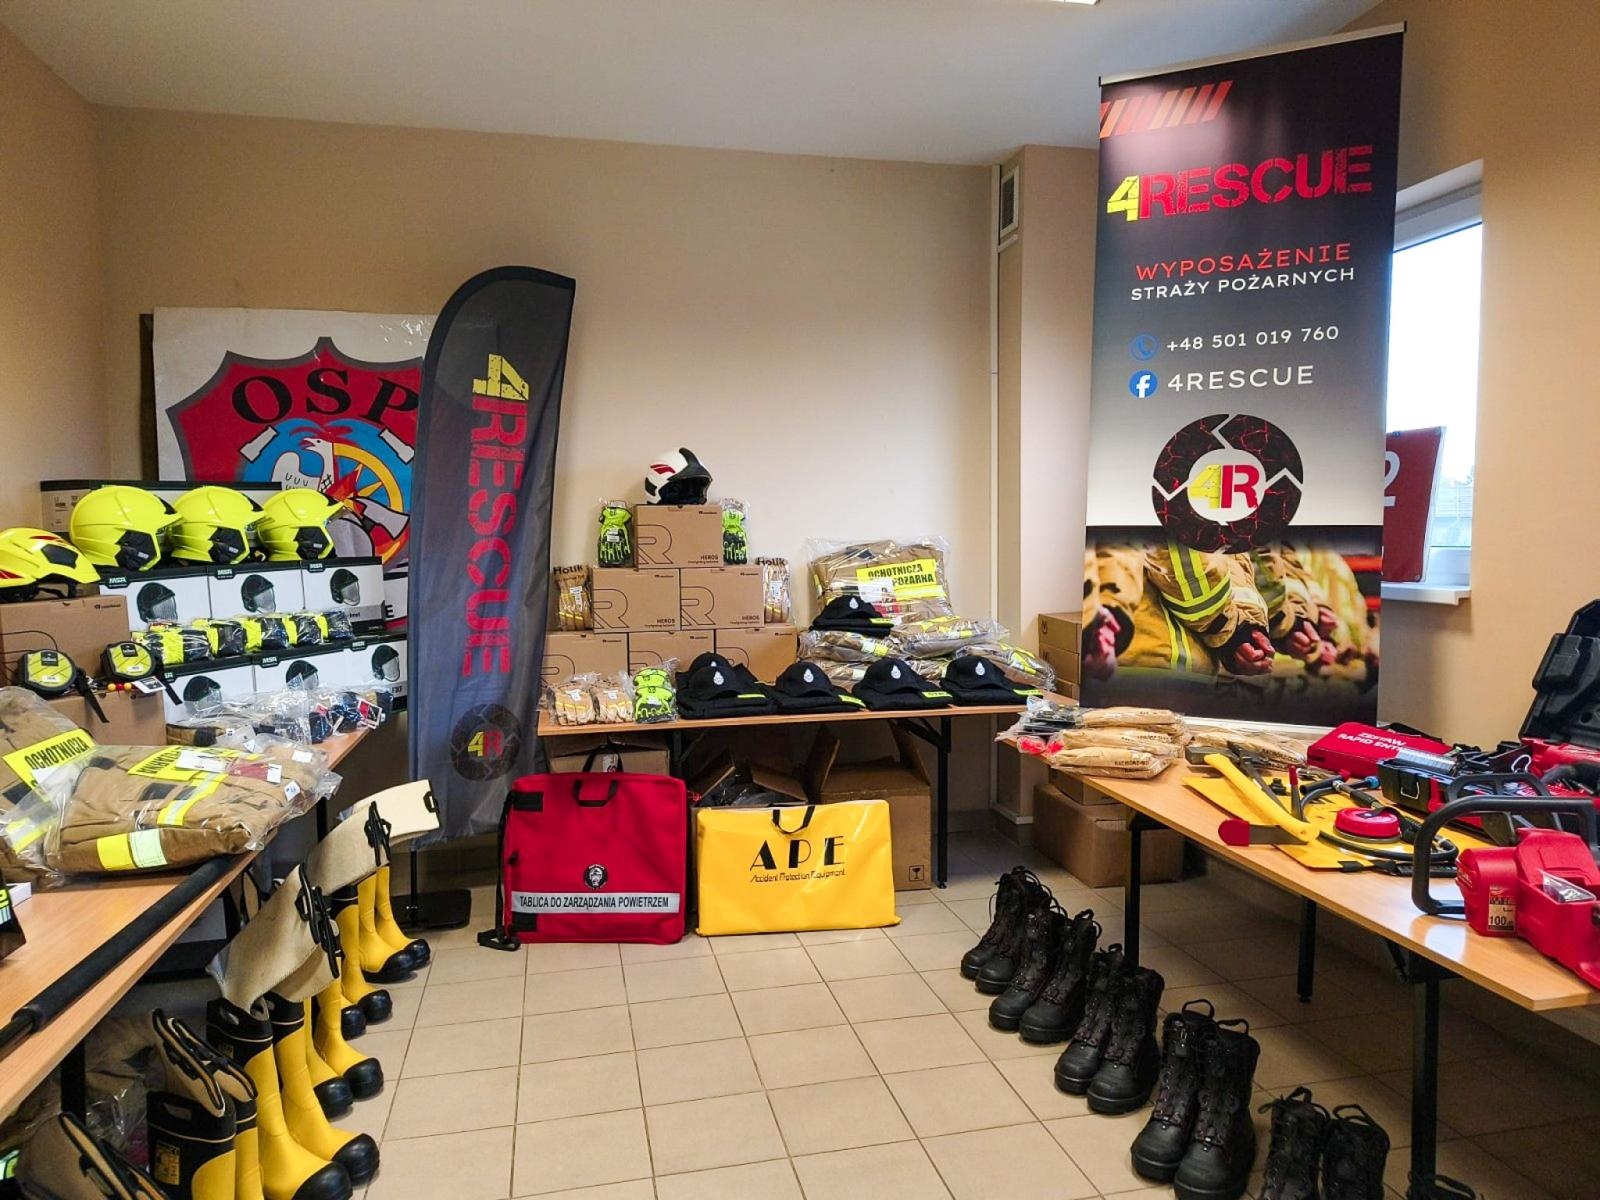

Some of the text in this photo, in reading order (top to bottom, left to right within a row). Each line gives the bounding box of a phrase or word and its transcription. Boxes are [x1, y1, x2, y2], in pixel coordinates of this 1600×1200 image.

[1106, 144, 1373, 221] 4RESCUE
[1136, 243, 1351, 281] WYPOSAŻENIE
[1131, 267, 1355, 302] STRAŻY POŻARNYCH
[1166, 325, 1340, 352] +48 501 019 760
[1167, 365, 1314, 392] 4RESCUE
[231, 367, 419, 425] OSP
[1186, 464, 1260, 510] 4R
[462, 353, 530, 678] 4RESCUE
[24, 736, 89, 770] OCHOTNICZA
[1337, 733, 1374, 745] RAPID
[1358, 732, 1407, 746] ZESTAW
[519, 895, 669, 910] TABLICA DO ZARZĄDZANIA POWIETRZEM
[1489, 916, 1506, 925] 100
